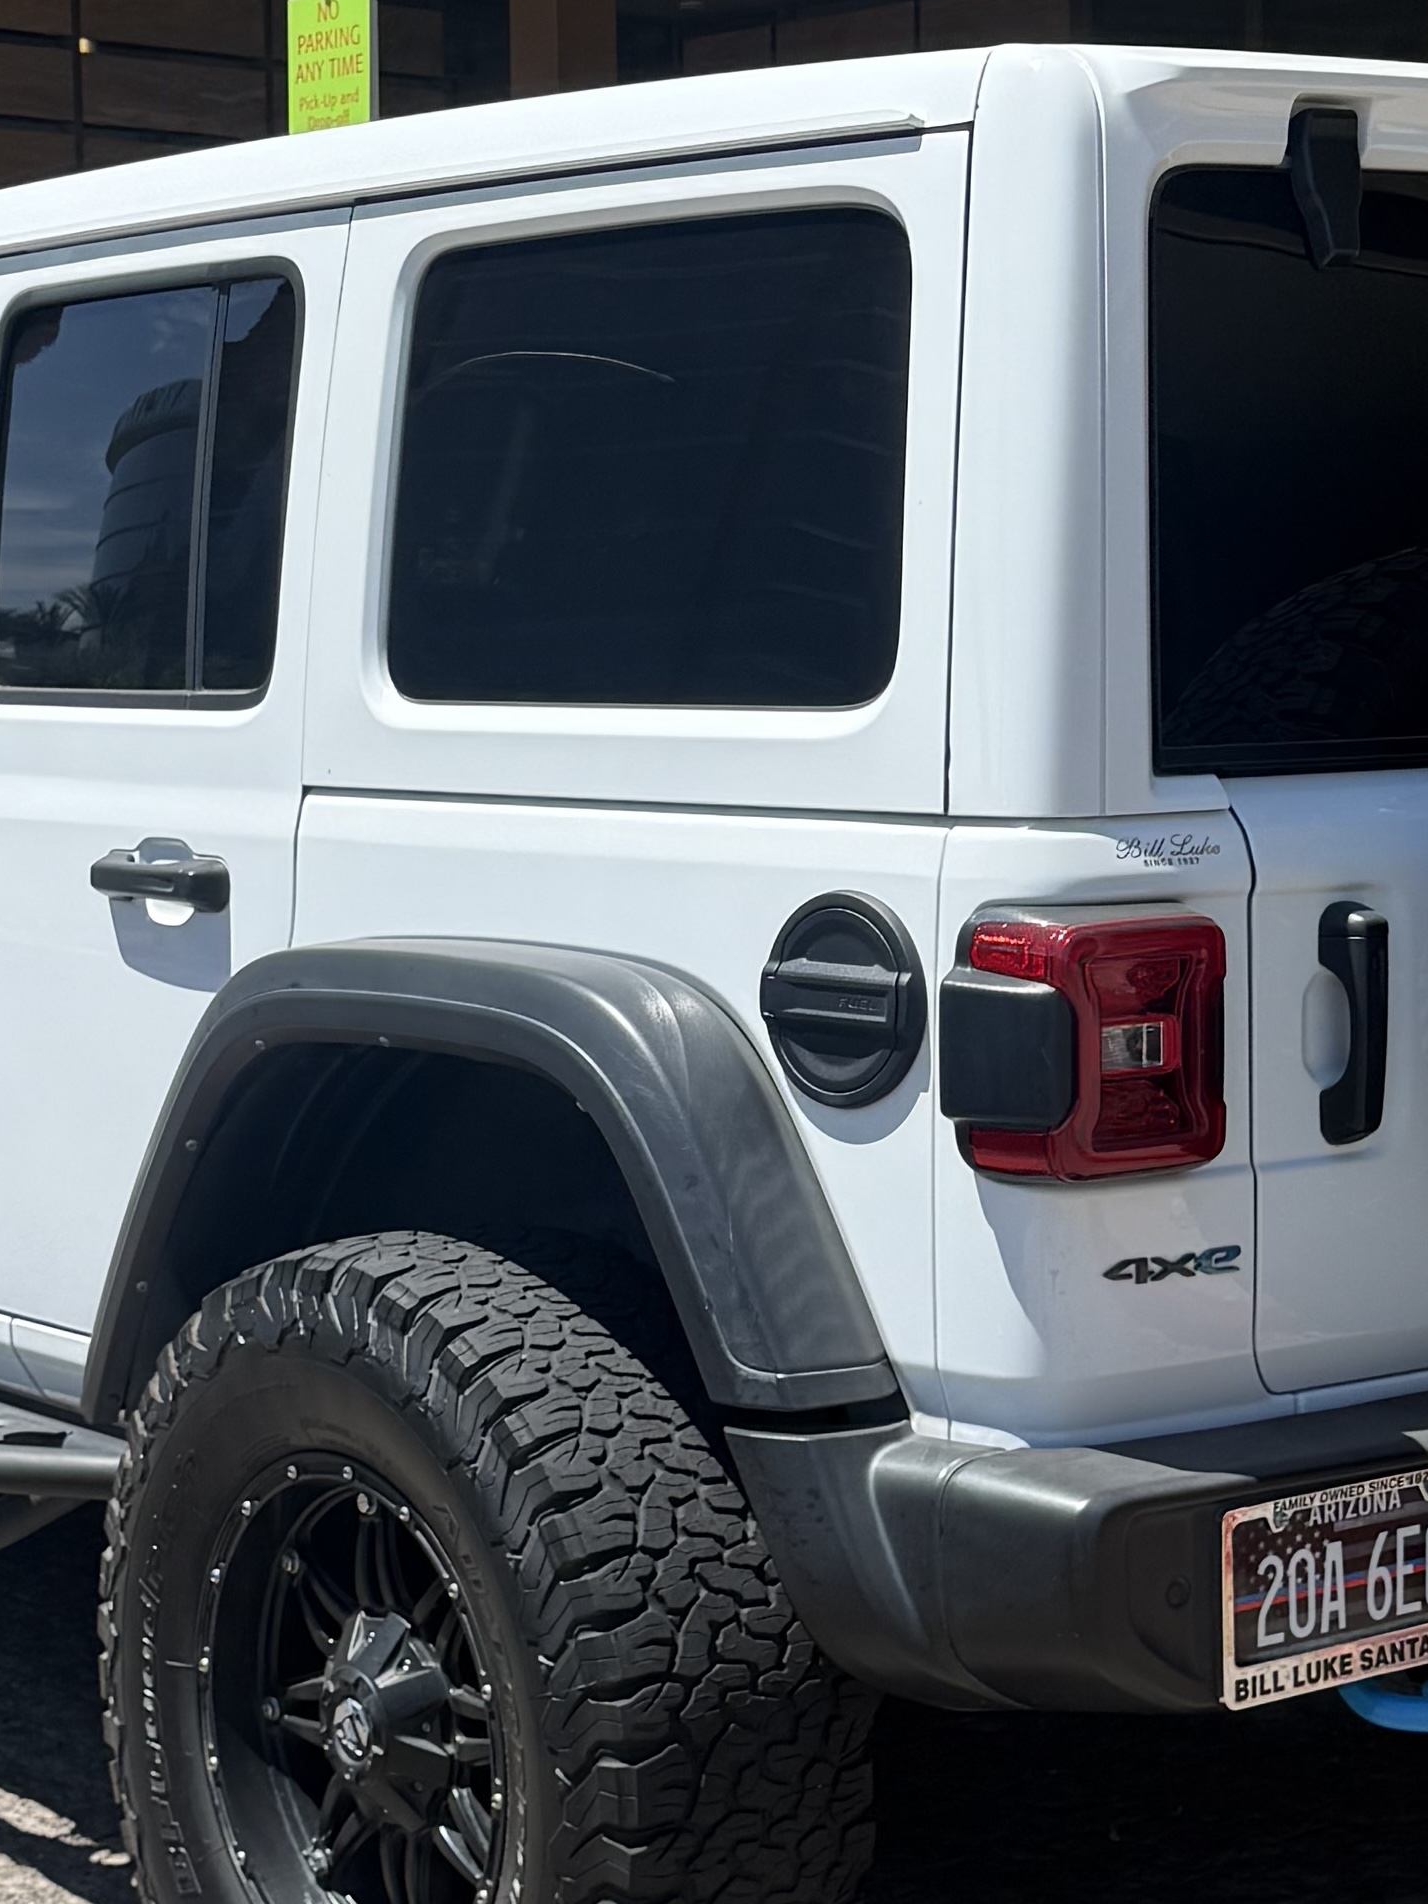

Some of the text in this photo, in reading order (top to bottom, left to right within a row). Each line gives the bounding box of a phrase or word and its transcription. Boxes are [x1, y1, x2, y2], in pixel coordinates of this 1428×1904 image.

[316, 0, 340, 24] NO
[297, 24, 361, 56] PARKING
[295, 52, 364, 85] ANY TIME
[299, 86, 359, 112] Pick-Up and
[1115, 833, 1221, 860] Bill Luke
[1143, 857, 1174, 868] SINCE
[838, 998, 880, 1012] FUEL
[1273, 1493, 1317, 1512] FAMILY
[1319, 1484, 1365, 1503] OWNED
[1368, 1476, 1404, 1493] SINCE
[1308, 1487, 1402, 1527] ARIZONA
[1234, 1670, 1285, 1703] BILL
[1292, 1653, 1353, 1688] LUKE
